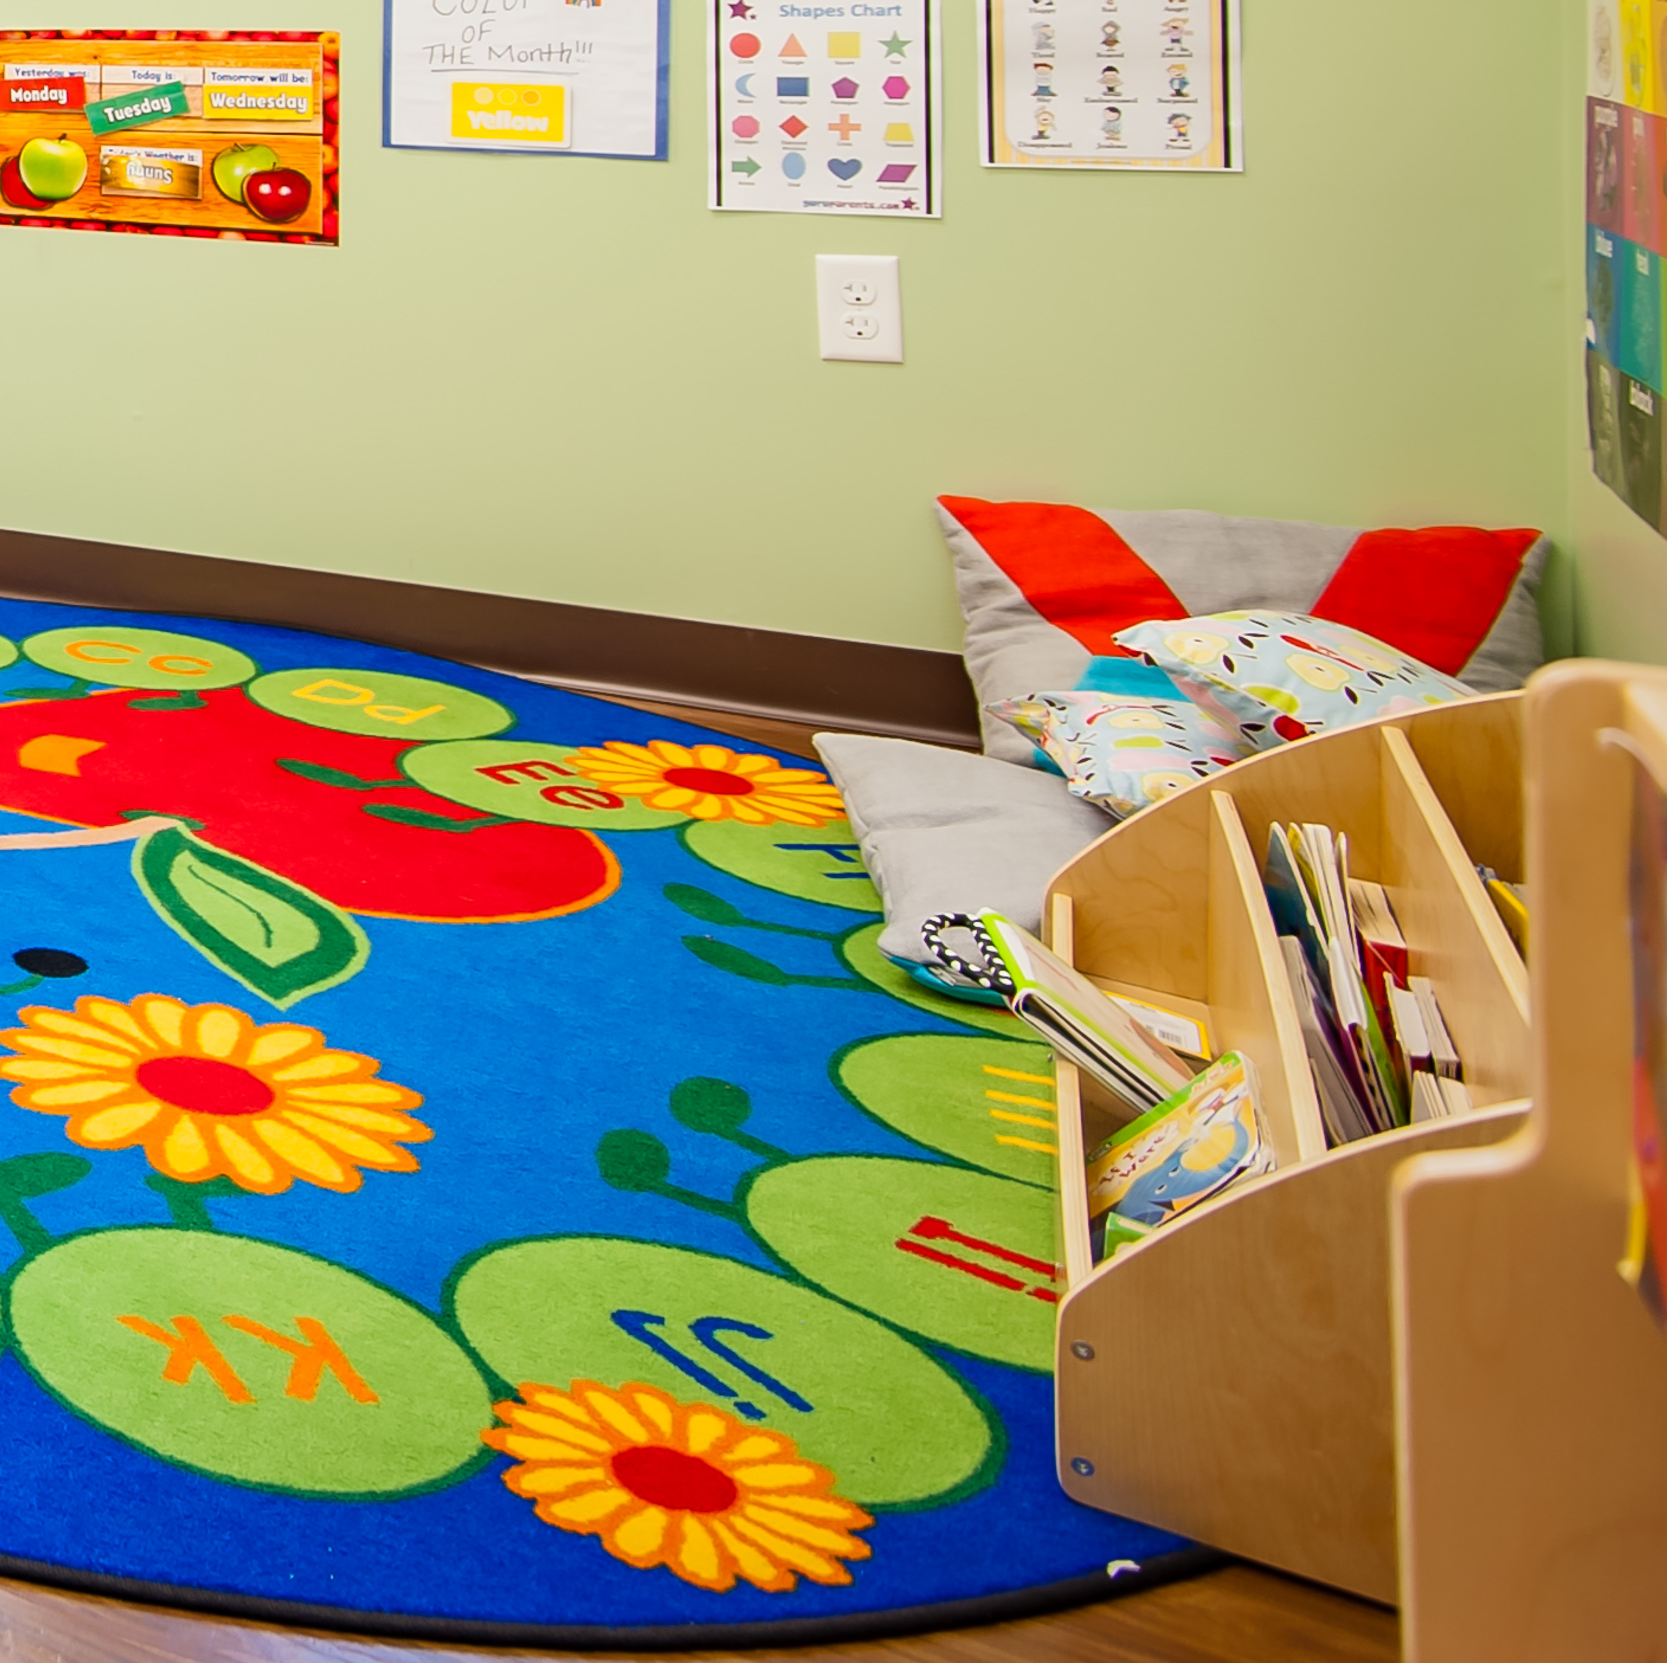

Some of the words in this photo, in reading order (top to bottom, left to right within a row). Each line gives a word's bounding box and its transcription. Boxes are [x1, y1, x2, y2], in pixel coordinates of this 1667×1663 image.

[779, 4, 845, 19] Shapes
[851, 4, 903, 17] Chart
[14, 68, 64, 78] Yesterday
[131, 70, 159, 82] Today
[211, 72, 264, 82] Tomorrow
[269, 72, 289, 83] will
[10, 85, 68, 105] Monday
[210, 92, 308, 114] Wednesday
[104, 95, 172, 124] Tuesday
[467, 110, 549, 133] Yellow
[126, 160, 173, 185] Sunny
[65, 639, 214, 678] Cc
[290, 678, 448, 726] Dd
[475, 758, 625, 813] Ee
